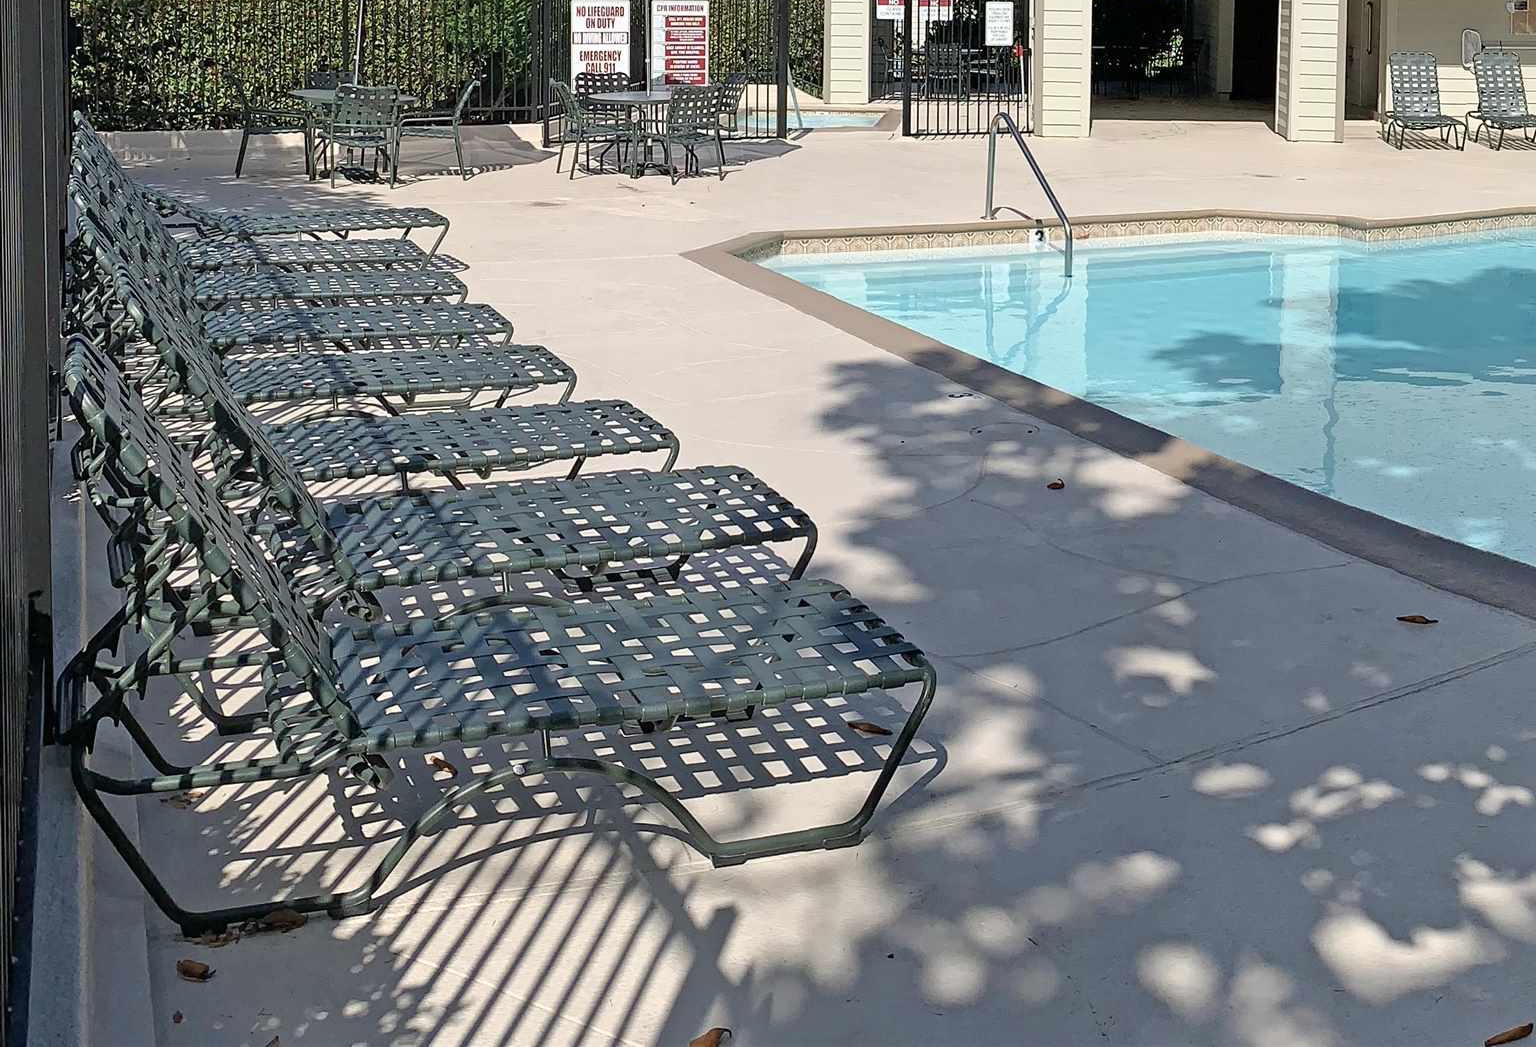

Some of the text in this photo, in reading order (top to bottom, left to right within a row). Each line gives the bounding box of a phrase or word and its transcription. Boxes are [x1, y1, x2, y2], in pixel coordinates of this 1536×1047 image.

[576, 6, 624, 16] NO LIFEGUARD
[586, 18, 615, 28] ON DUTY
[580, 51, 621, 61] EMERGENCY
[586, 63, 615, 72] CALL 911
